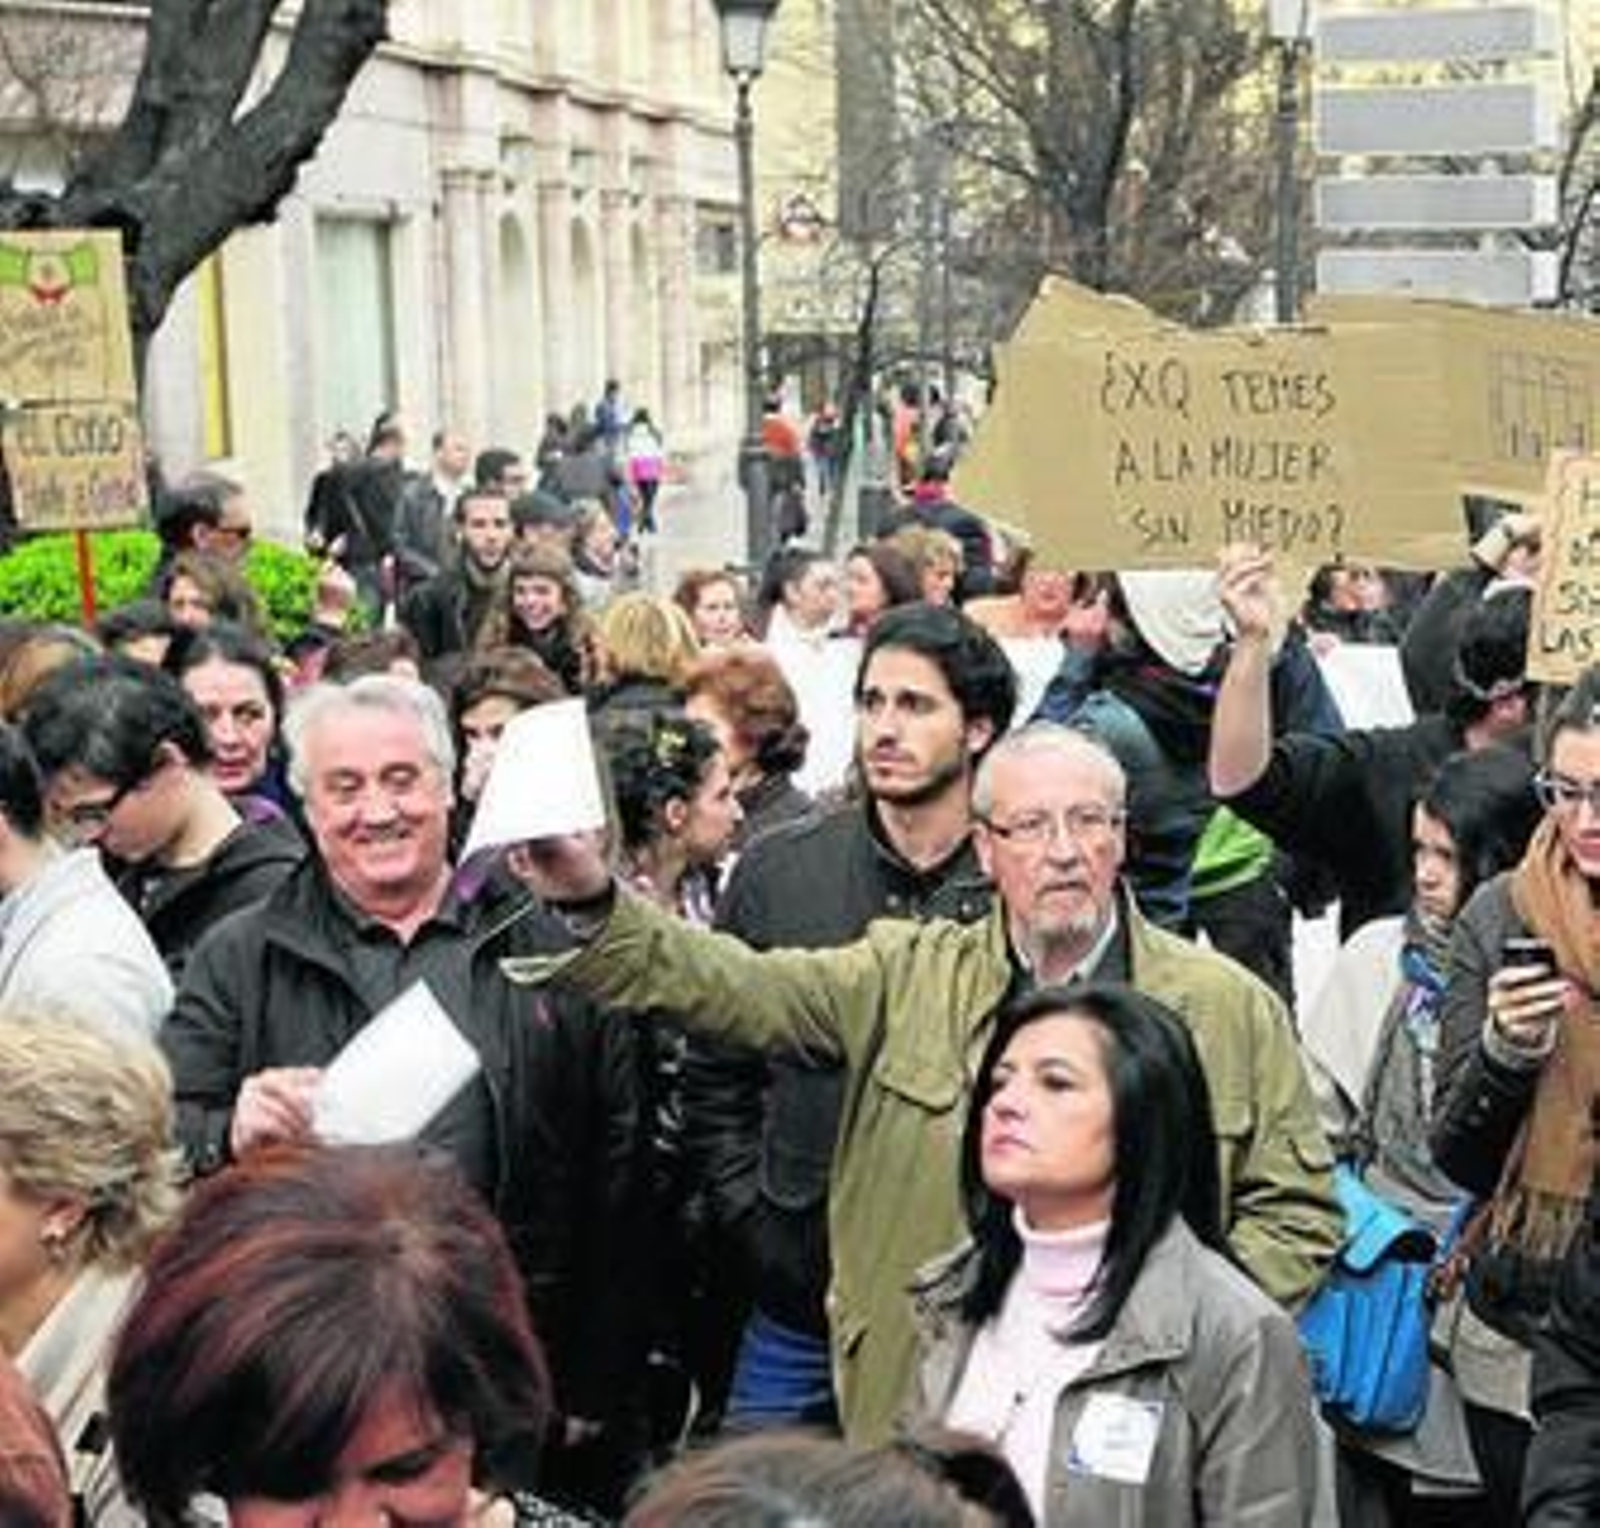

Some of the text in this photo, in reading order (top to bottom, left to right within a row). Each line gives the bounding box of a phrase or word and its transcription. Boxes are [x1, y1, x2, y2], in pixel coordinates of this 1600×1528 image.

[1219, 370, 1337, 419] TEMES
[1114, 435, 1333, 487] A LA MUJER
[1131, 499, 1346, 564] SIN MIEDO?
